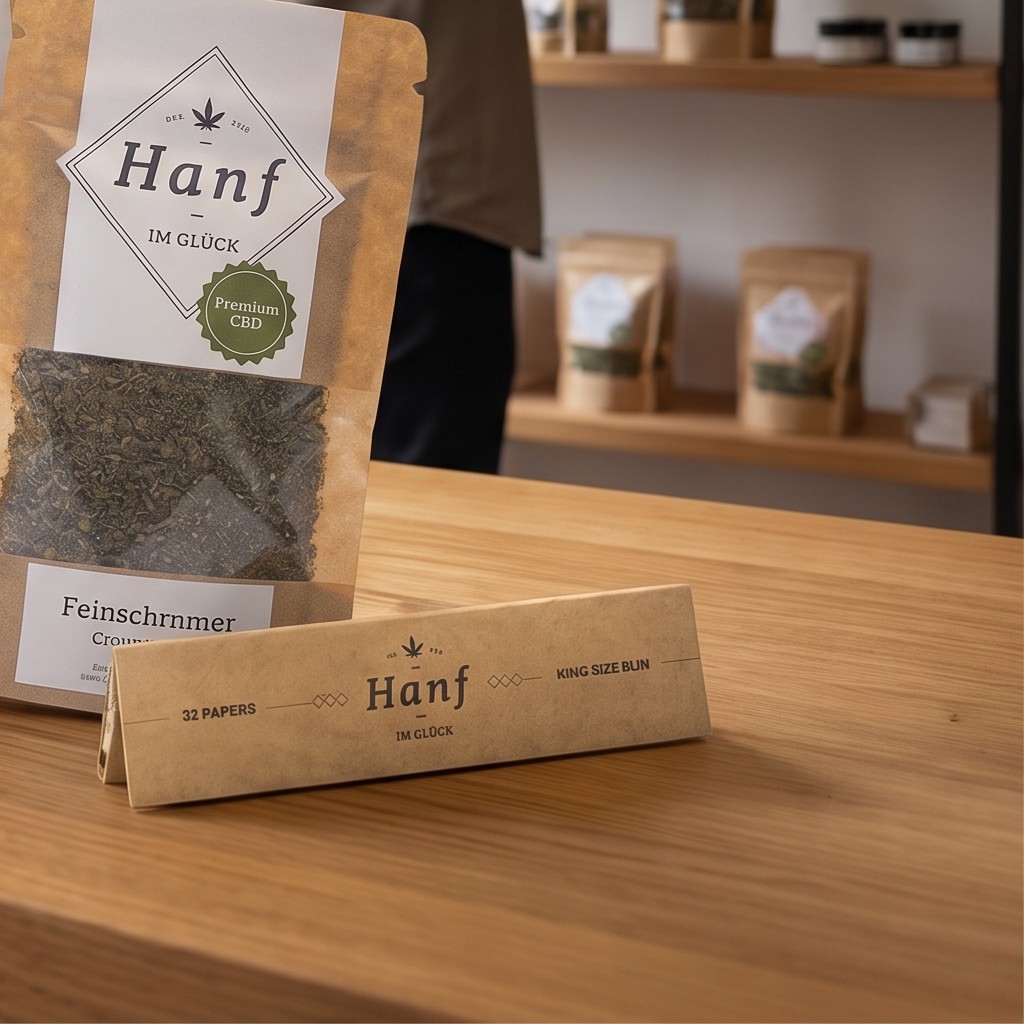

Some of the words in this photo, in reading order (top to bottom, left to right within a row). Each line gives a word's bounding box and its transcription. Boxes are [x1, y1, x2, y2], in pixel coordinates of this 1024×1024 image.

[114, 141, 286, 217] Hanf
[148, 229, 171, 245] IM
[177, 232, 239, 254] GLÜCK
[215, 296, 279, 316] Premium
[230, 314, 262, 329] CBD
[557, 666, 589, 679] KING
[591, 662, 620, 676] SIZE
[366, 664, 470, 711] Hanf
[182, 709, 199, 722] 32
[201, 702, 256, 720] PAPERS
[396, 731, 412, 742] IM
